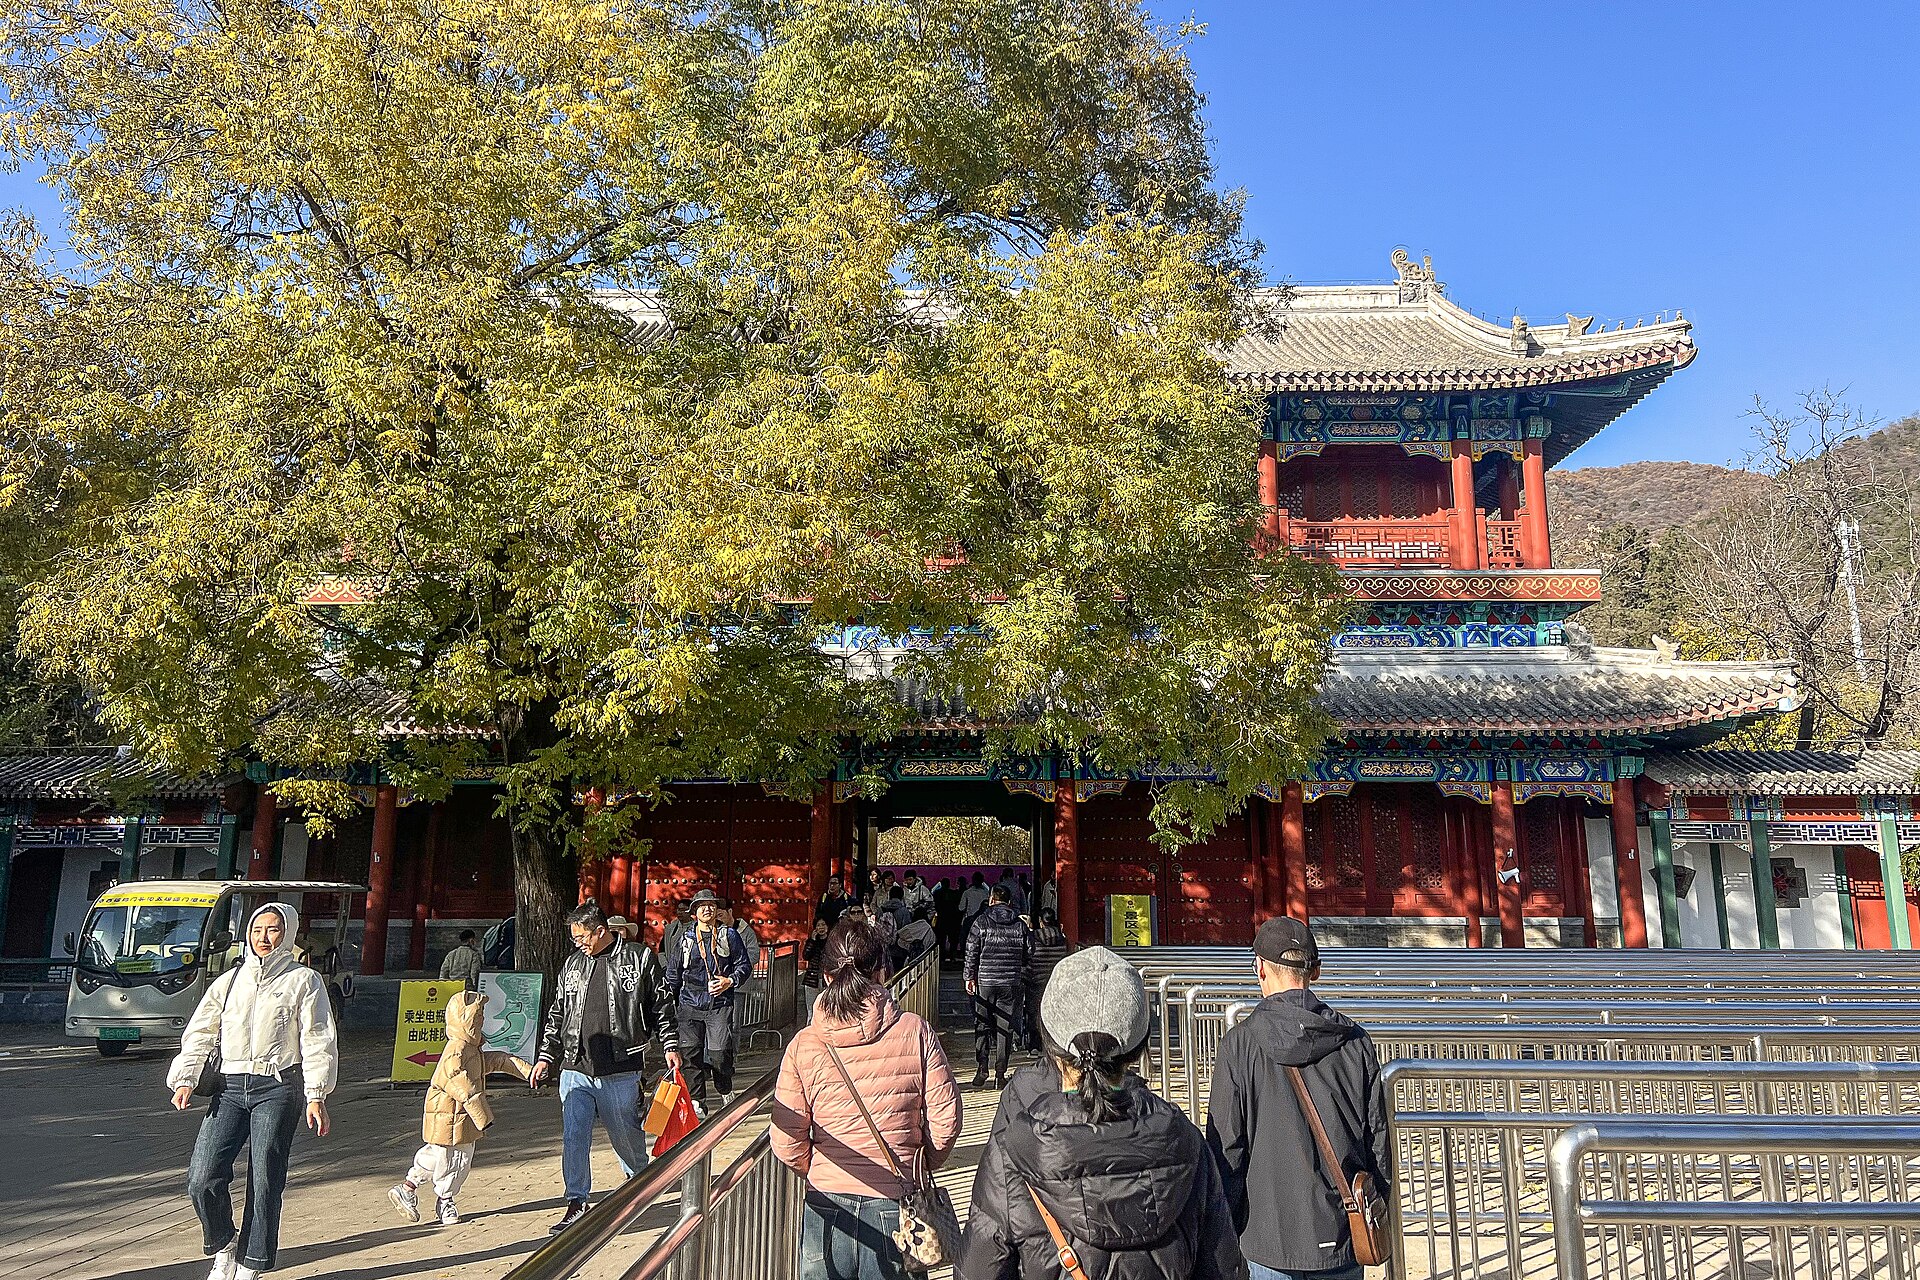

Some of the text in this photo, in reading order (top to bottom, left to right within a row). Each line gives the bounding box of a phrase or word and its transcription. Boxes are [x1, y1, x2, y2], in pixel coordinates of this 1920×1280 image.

[1123, 911, 1139, 946] 景区入口
[404, 1009, 446, 1024] 乘坐电瓶
[408, 1028, 446, 1042] 由此排队
